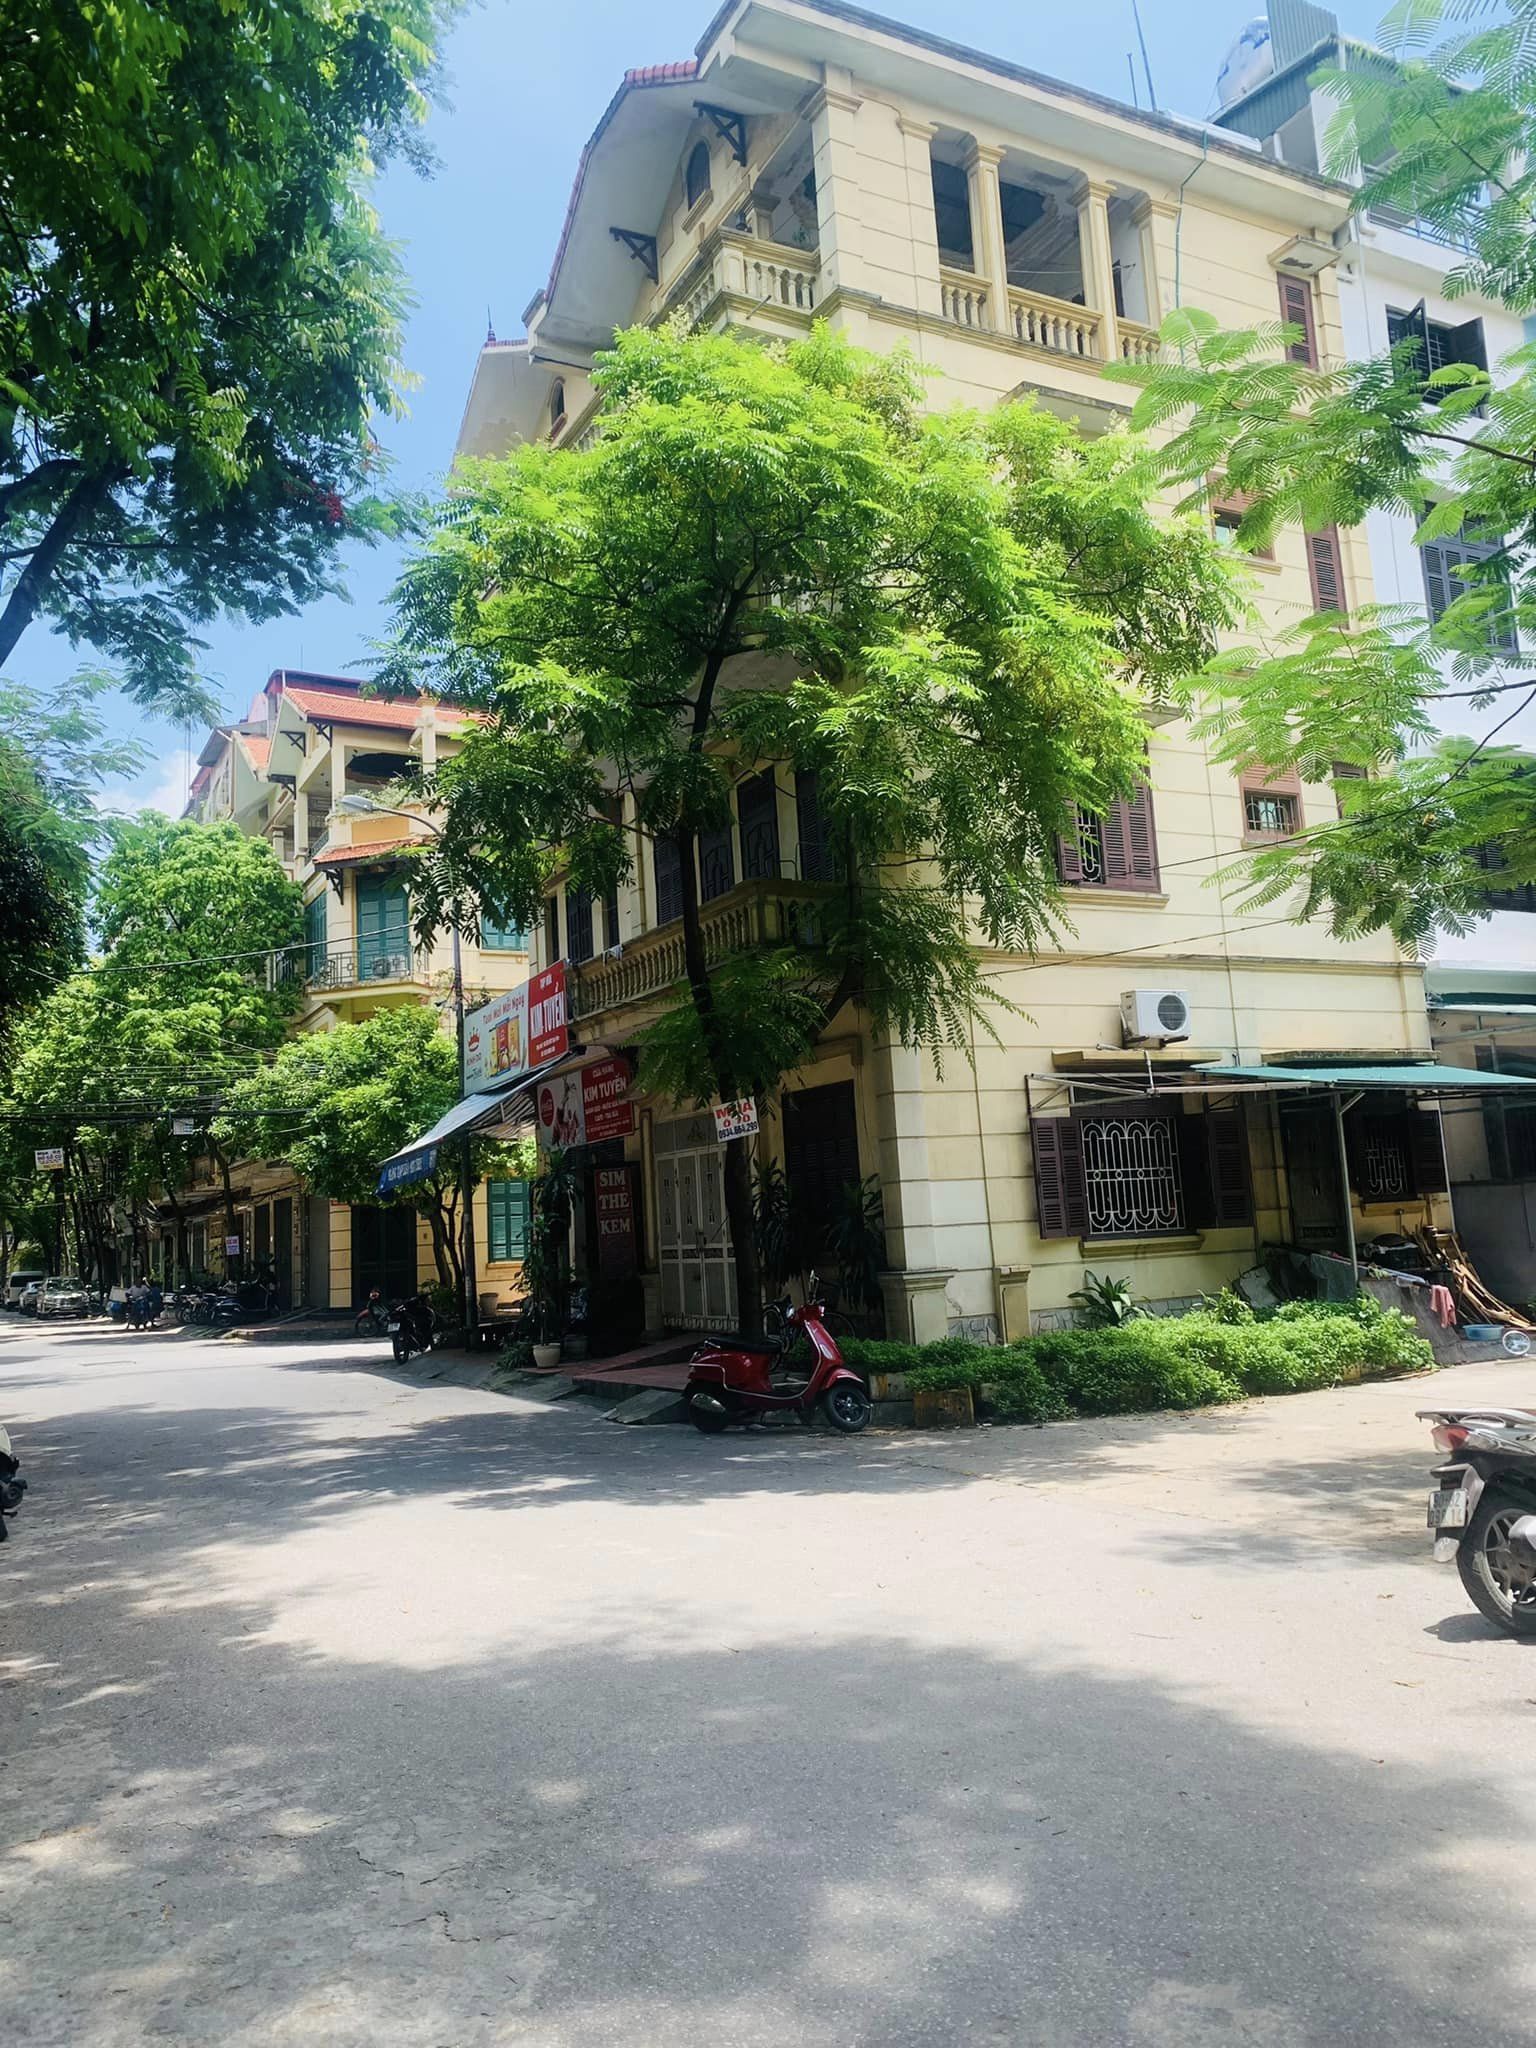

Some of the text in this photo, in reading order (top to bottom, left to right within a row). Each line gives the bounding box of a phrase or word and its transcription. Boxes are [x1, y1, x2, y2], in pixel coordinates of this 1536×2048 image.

[583, 1085, 598, 1103] KIM
[716, 1102, 753, 1119] MA
[600, 1170, 626, 1187] SIM
[600, 1218, 631, 1235] KEM
